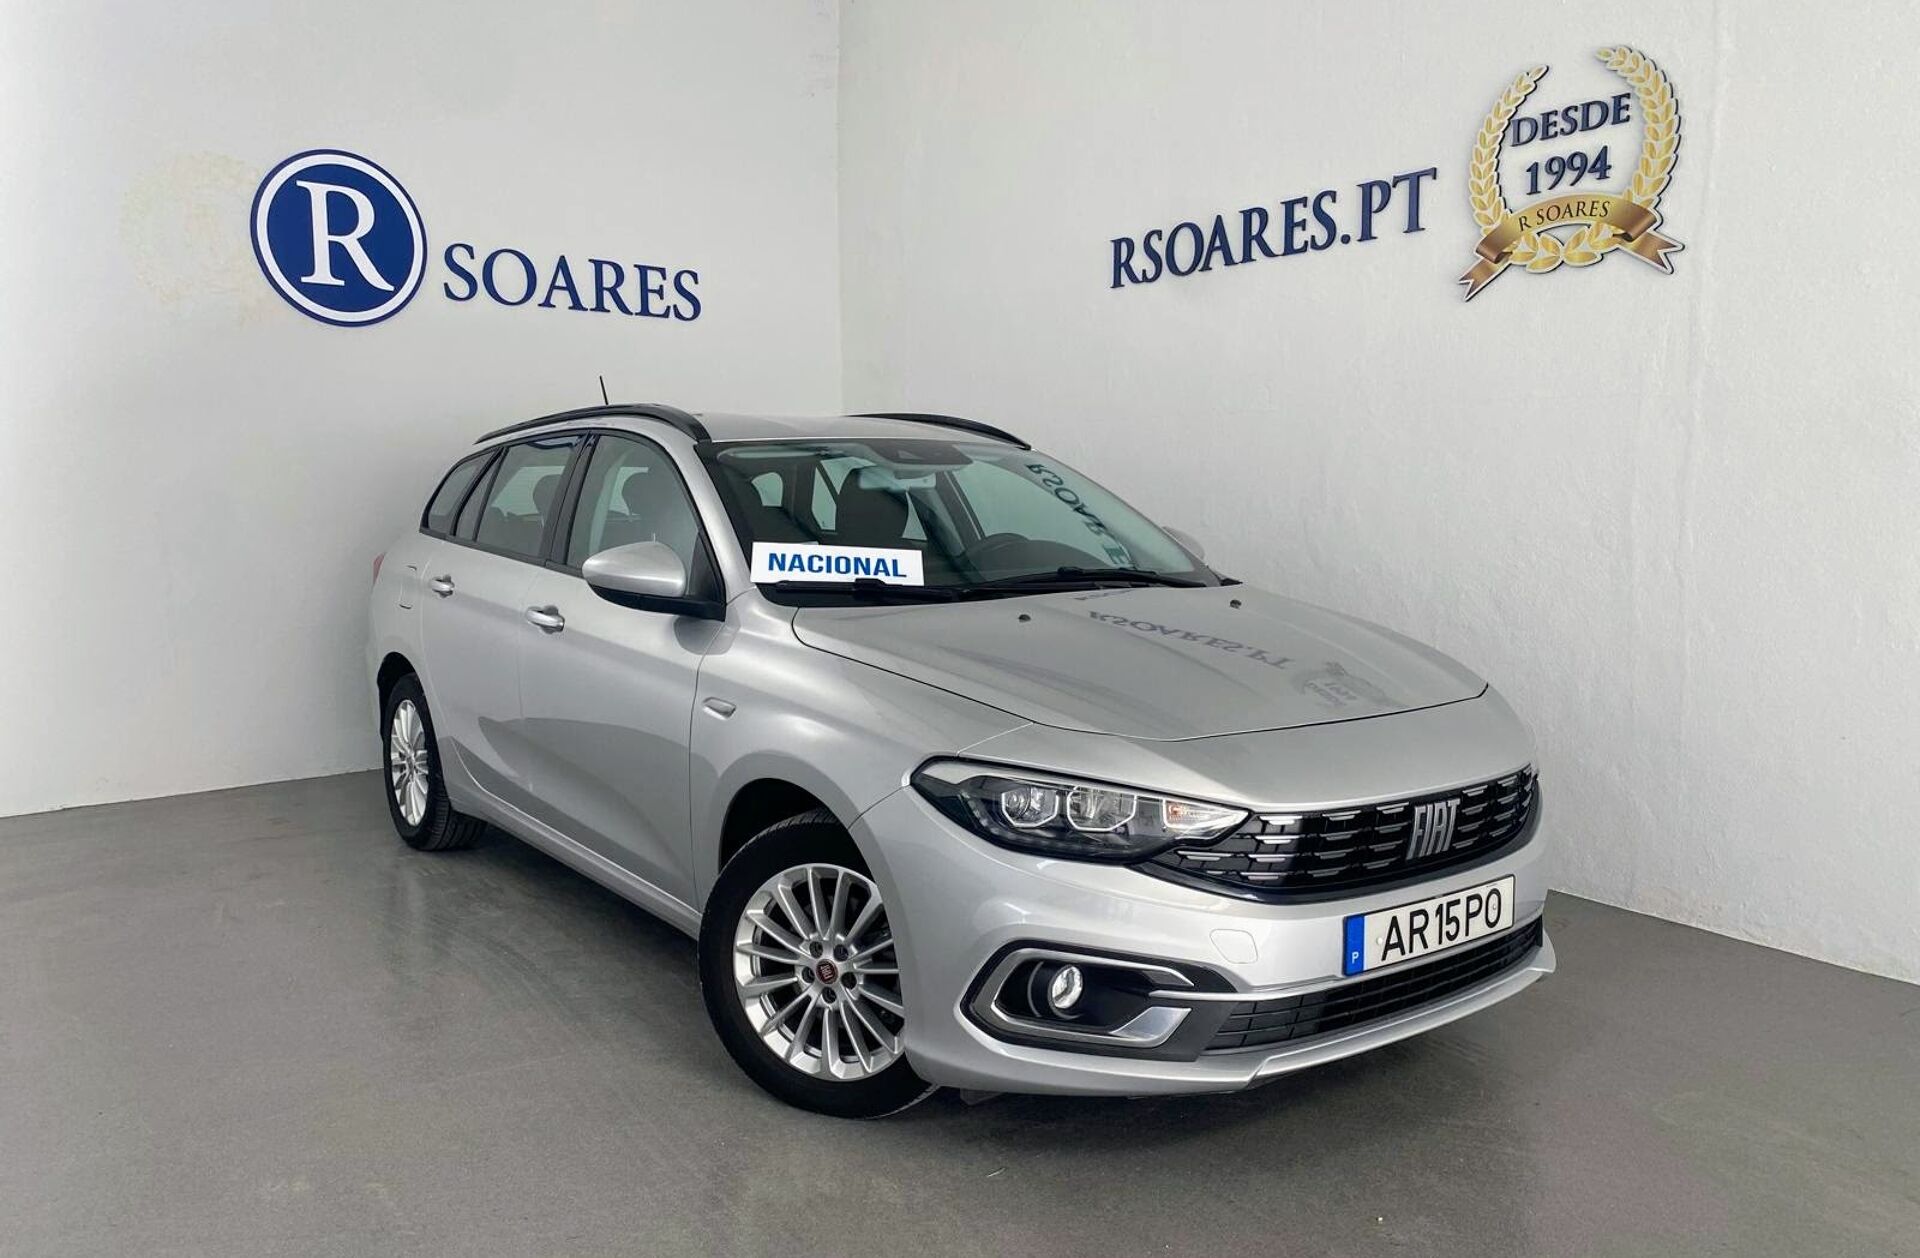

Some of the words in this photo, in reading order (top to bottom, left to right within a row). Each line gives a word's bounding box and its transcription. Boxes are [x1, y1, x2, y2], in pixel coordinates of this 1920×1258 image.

[1510, 93, 1631, 147] DESDE
[1526, 145, 1612, 195] 1994
[1110, 167, 1437, 289] RSOARES.PT
[1519, 215, 1532, 231] R
[1536, 200, 1610, 225] SOARES
[296, 180, 395, 292] R
[444, 244, 702, 321] SOARES
[768, 552, 907, 578] NACIONAL
[1406, 798, 1461, 861] FIAT
[1351, 952, 1360, 964] P
